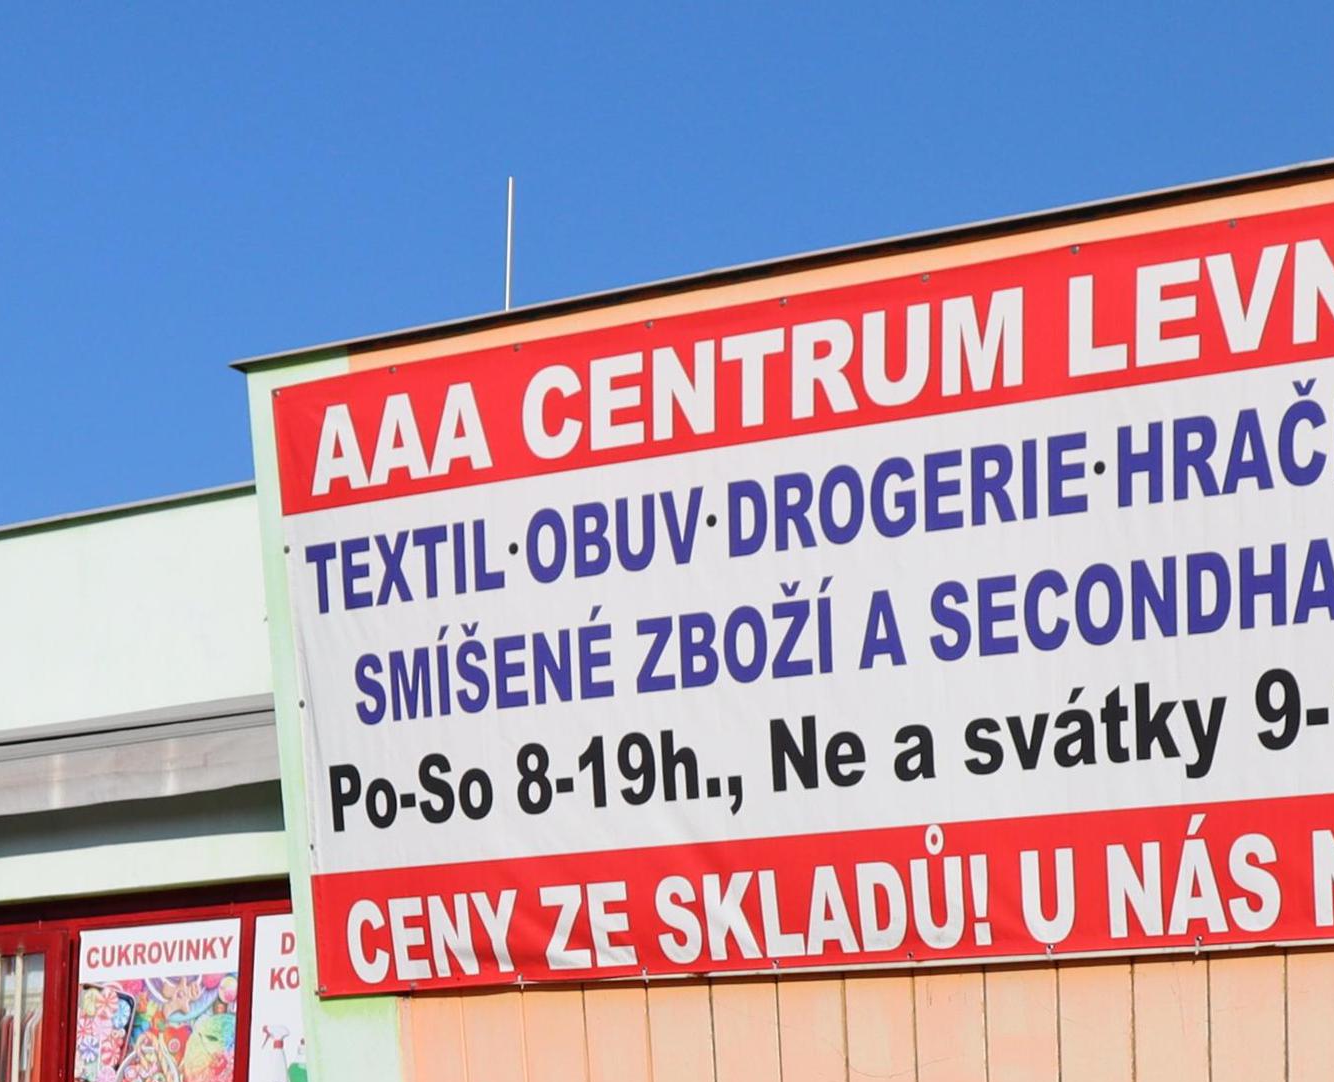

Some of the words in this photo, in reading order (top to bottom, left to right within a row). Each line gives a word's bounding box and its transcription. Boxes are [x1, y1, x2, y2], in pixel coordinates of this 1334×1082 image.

[311, 382, 493, 496] AAA
[522, 287, 1024, 459] CENTRUM
[355, 605, 615, 725] SMÍŠENÉ
[636, 577, 834, 693] ZBOŽÍ
[860, 590, 907, 670] A
[329, 753, 493, 832] Po-So
[516, 730, 744, 815] 8-19h.,
[770, 715, 866, 793] Ne
[894, 723, 935, 782] a
[964, 682, 1227, 779] svátky
[86, 936, 234, 969] CUKROVINKY
[347, 889, 517, 984] CENY
[539, 881, 638, 970] ZE
[655, 823, 992, 964] SKLADŮ!
[1020, 847, 1075, 944] U
[1106, 813, 1281, 939] NÁS
